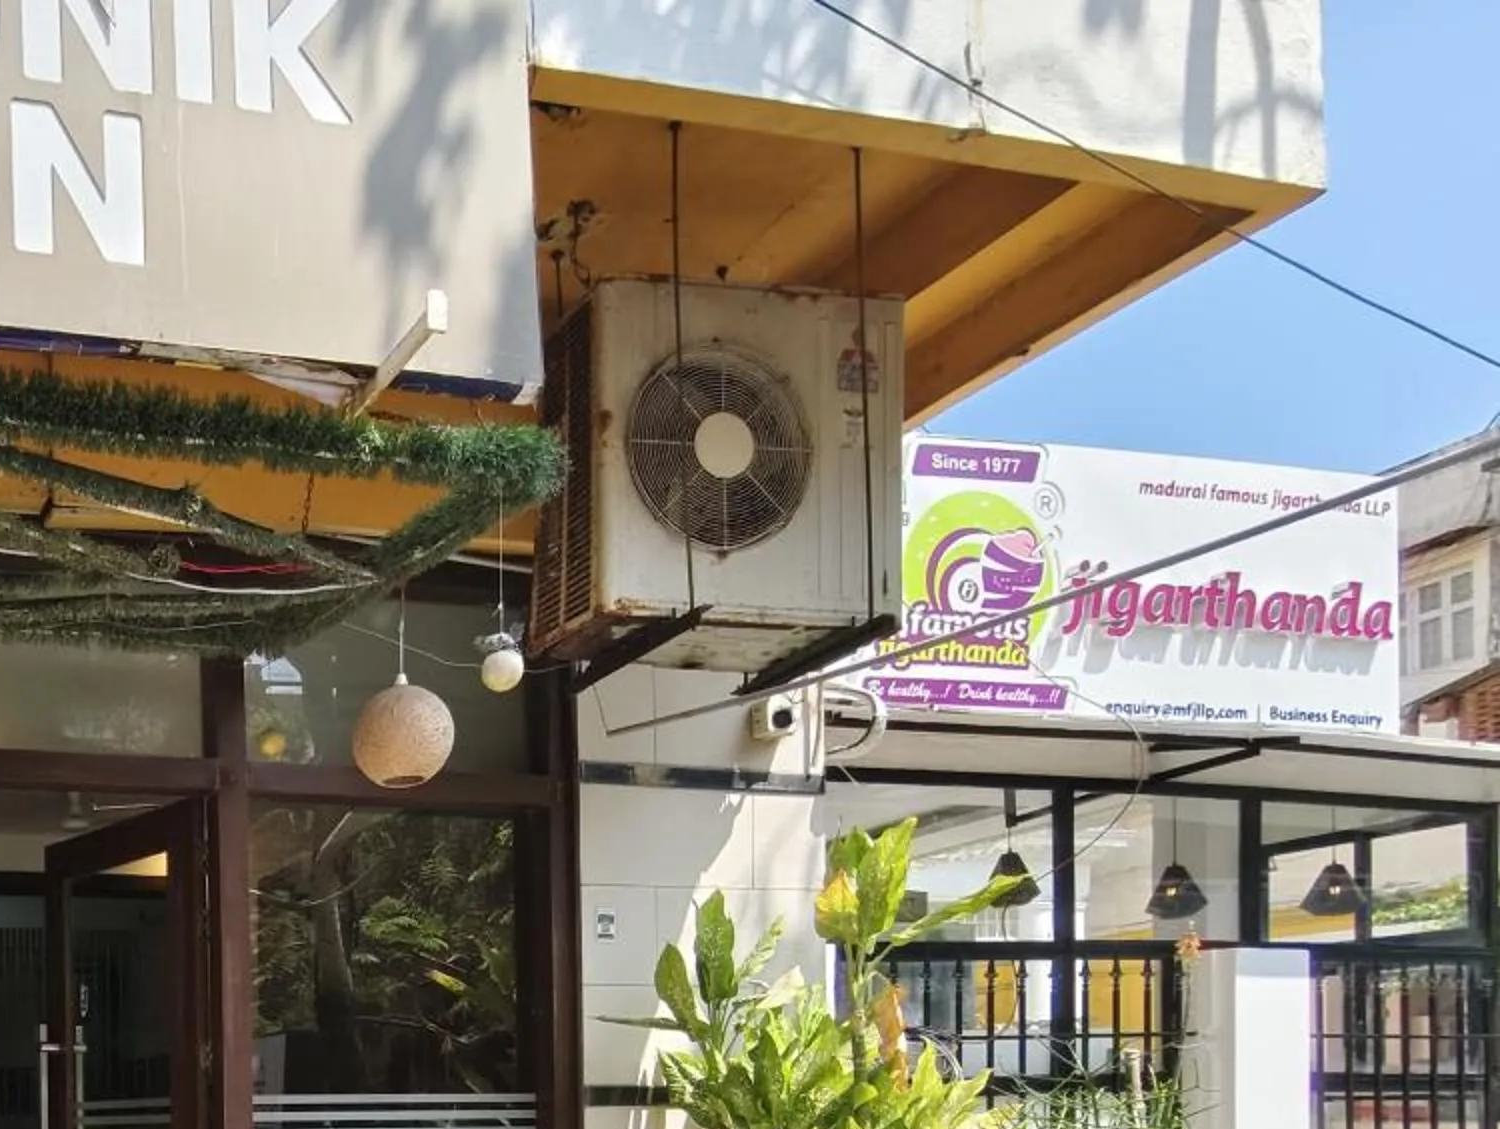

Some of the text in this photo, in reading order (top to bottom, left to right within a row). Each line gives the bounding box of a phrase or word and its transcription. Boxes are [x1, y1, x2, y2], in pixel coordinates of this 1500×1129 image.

[931, 453, 1021, 474] Since 1977
[1139, 480, 1391, 517] madurai famous jigartda LLP
[1062, 571, 1393, 640] jigarthanda
[958, 683, 993, 700] Drink
[1269, 705, 1328, 723] Business
[1331, 709, 1383, 729] Enquiry
